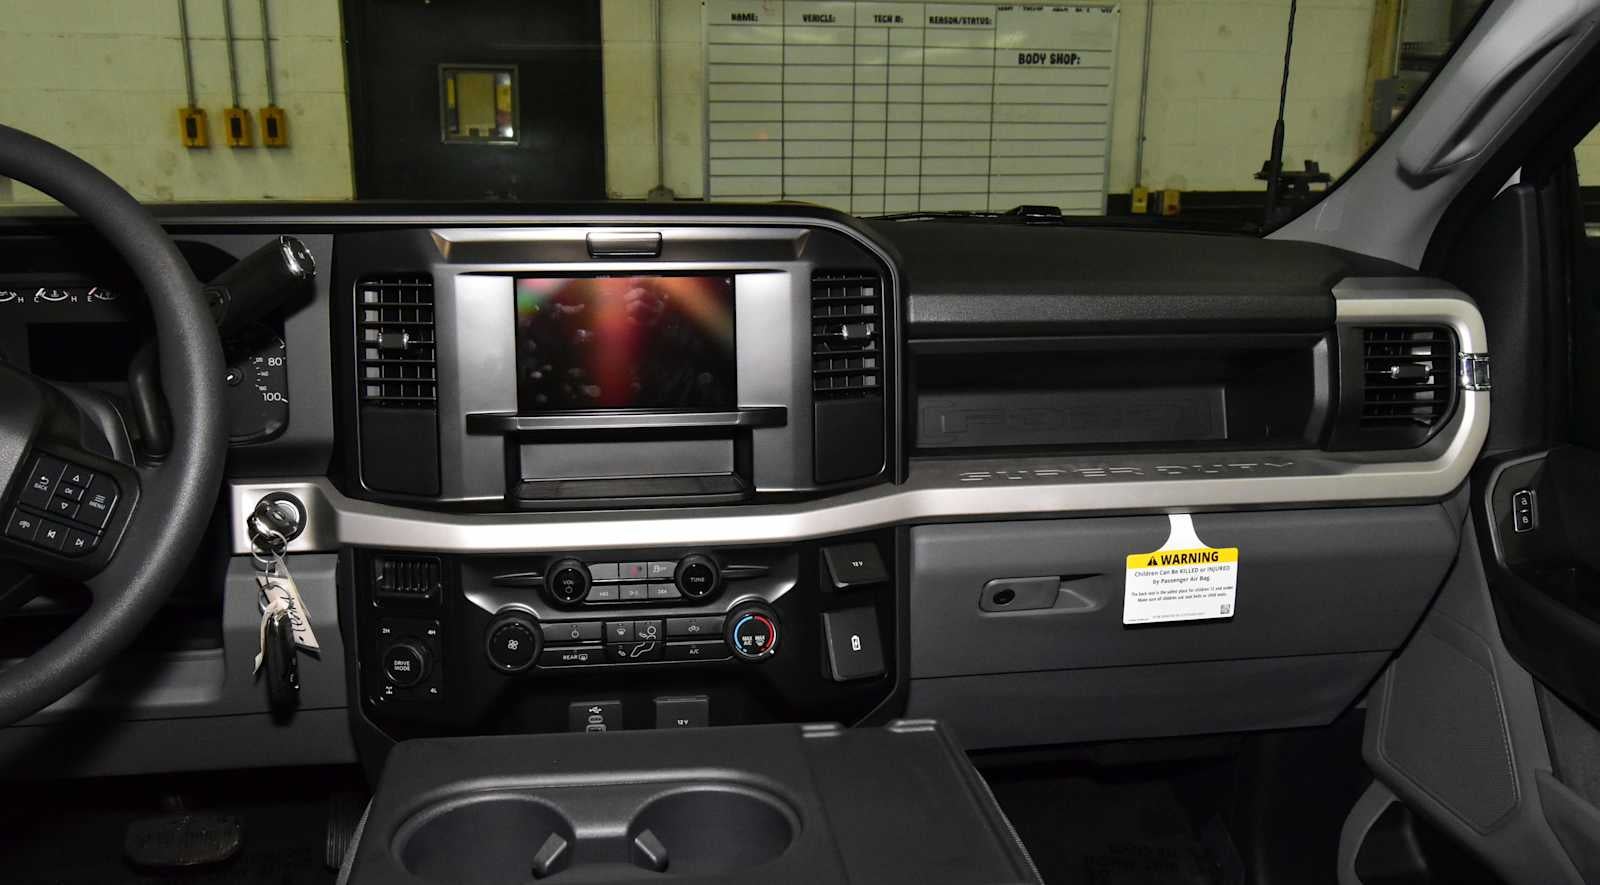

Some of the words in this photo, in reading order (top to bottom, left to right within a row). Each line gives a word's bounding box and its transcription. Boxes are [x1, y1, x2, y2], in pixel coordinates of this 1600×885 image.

[730, 13, 758, 22] NAME:
[802, 14, 836, 23] VEHICLE:
[873, 14, 892, 23] TECH
[928, 16, 992, 25] REASON/STATUS:
[1018, 52, 1047, 65] BODY
[1049, 52, 1081, 65] SHOP:
[267, 357, 283, 367] 80
[262, 392, 282, 402] 100
[1160, 551, 1219, 566] WARNING
[1134, 569, 1159, 577] Children
[1206, 565, 1231, 573] INJURED
